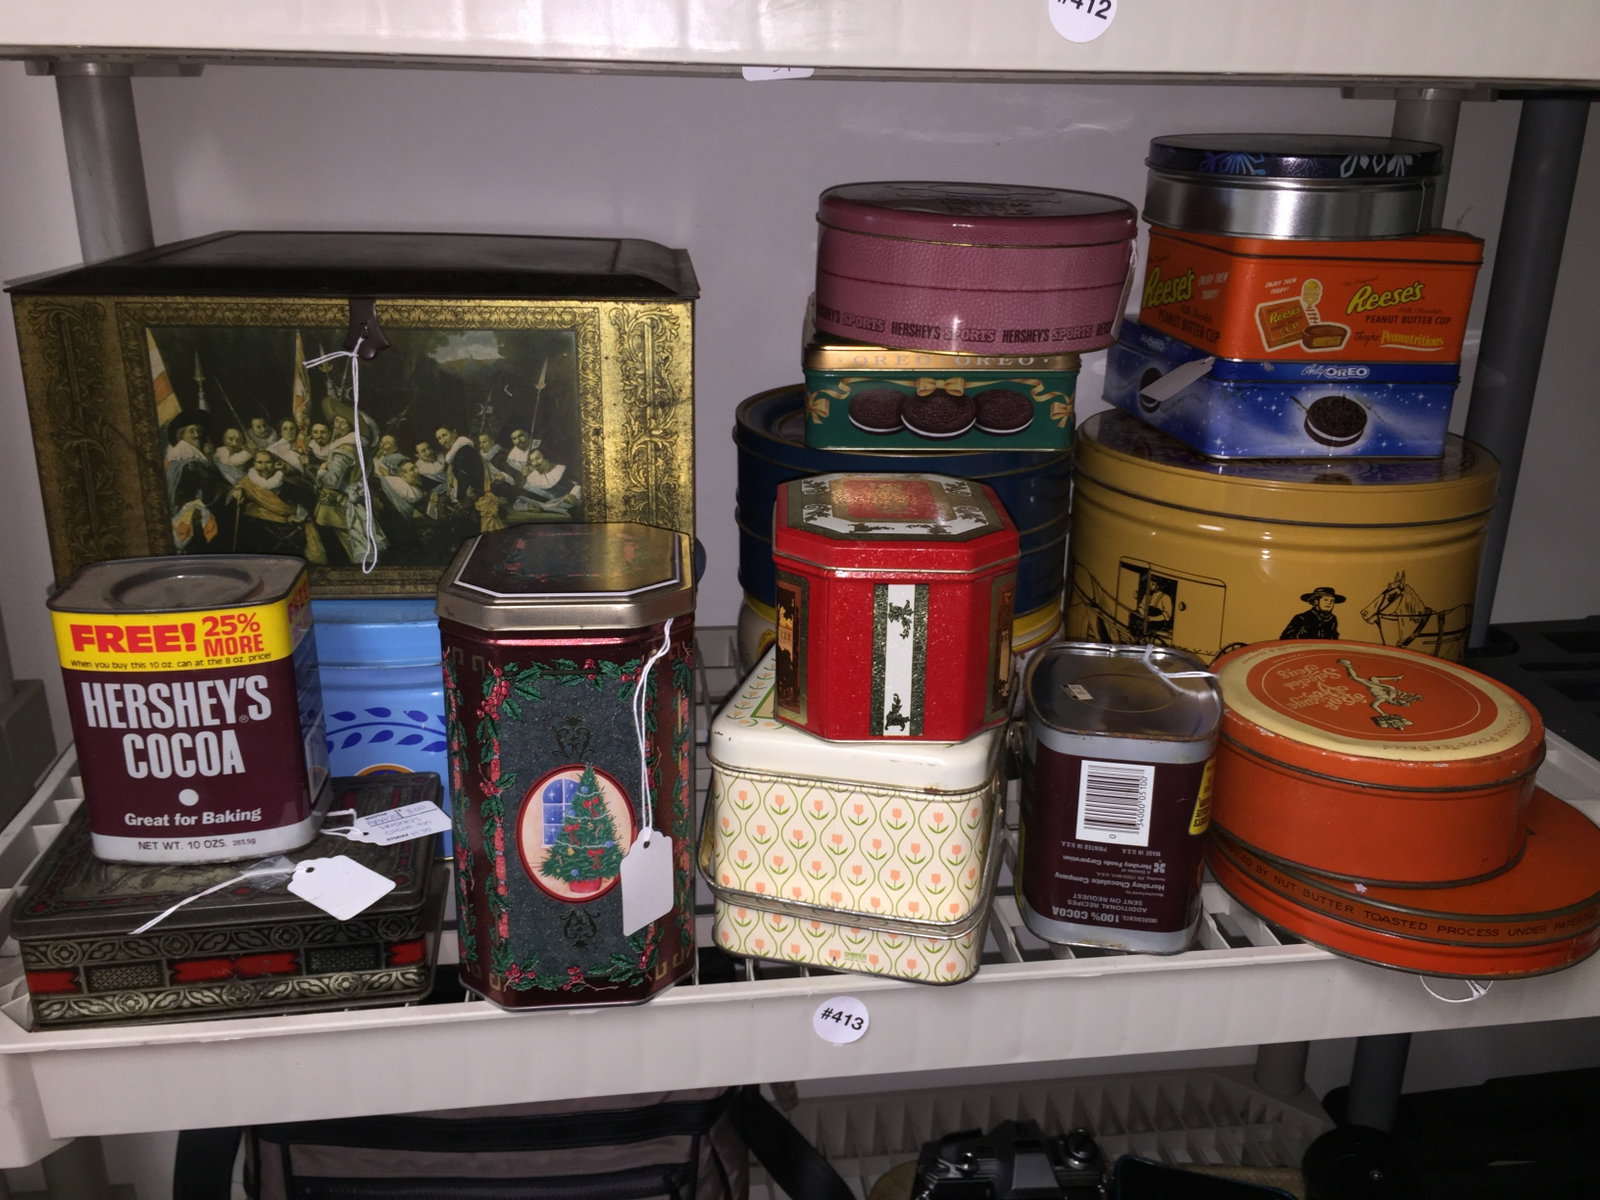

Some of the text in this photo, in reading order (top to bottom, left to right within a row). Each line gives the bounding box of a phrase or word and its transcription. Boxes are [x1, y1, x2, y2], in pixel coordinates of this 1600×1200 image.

[1057, 0, 1112, 20] 412
[1345, 281, 1425, 315] Reese's
[843, 311, 885, 333] SPORTS
[891, 321, 941, 340] HERSHEY'S
[944, 328, 995, 343] SPORTS
[1002, 328, 1050, 343] HERSHEY'S
[1052, 325, 1093, 341] SPORTS
[1365, 314, 1452, 326] PEANUT BUTTER CUP
[1206, 328, 1221, 344] CUP
[1325, 366, 1370, 379] OREO
[202, 612, 261, 637] 25%
[69, 623, 197, 653] FREE!
[203, 634, 264, 657] MORE
[71, 659, 92, 667] When
[95, 661, 110, 670] you
[112, 660, 127, 670] buy
[131, 660, 146, 669] this
[150, 660, 159, 669] 10
[177, 660, 192, 668] can
[195, 659, 204, 667] at
[207, 657, 223, 666] the
[225, 656, 231, 665] 8
[81, 675, 272, 729] HERSHEY'S
[122, 729, 246, 779] COCOA
[124, 807, 262, 827] Great for Baking
[138, 841, 159, 850] NET
[163, 840, 184, 850] WT.
[188, 840, 200, 850] 10
[1124, 861, 1152, 871] Hershey
[1054, 871, 1165, 891] Hershey Chocolate Company
[1067, 899, 1148, 913] ADDITIONAL RECIPES
[1073, 893, 1109, 903] REQUEST
[1122, 899, 1143, 907] SENT
[1255, 866, 1269, 877] BY
[1273, 875, 1297, 891] NUT
[1303, 888, 1355, 914] BUTTER
[1364, 910, 1429, 931] TOASTED
[1437, 925, 1500, 937] PROCESS
[1508, 924, 1547, 937] UNDER
[1052, 905, 1089, 920] COCOA
[1090, 912, 1120, 923] 100%
[821, 1007, 864, 1031] #413
